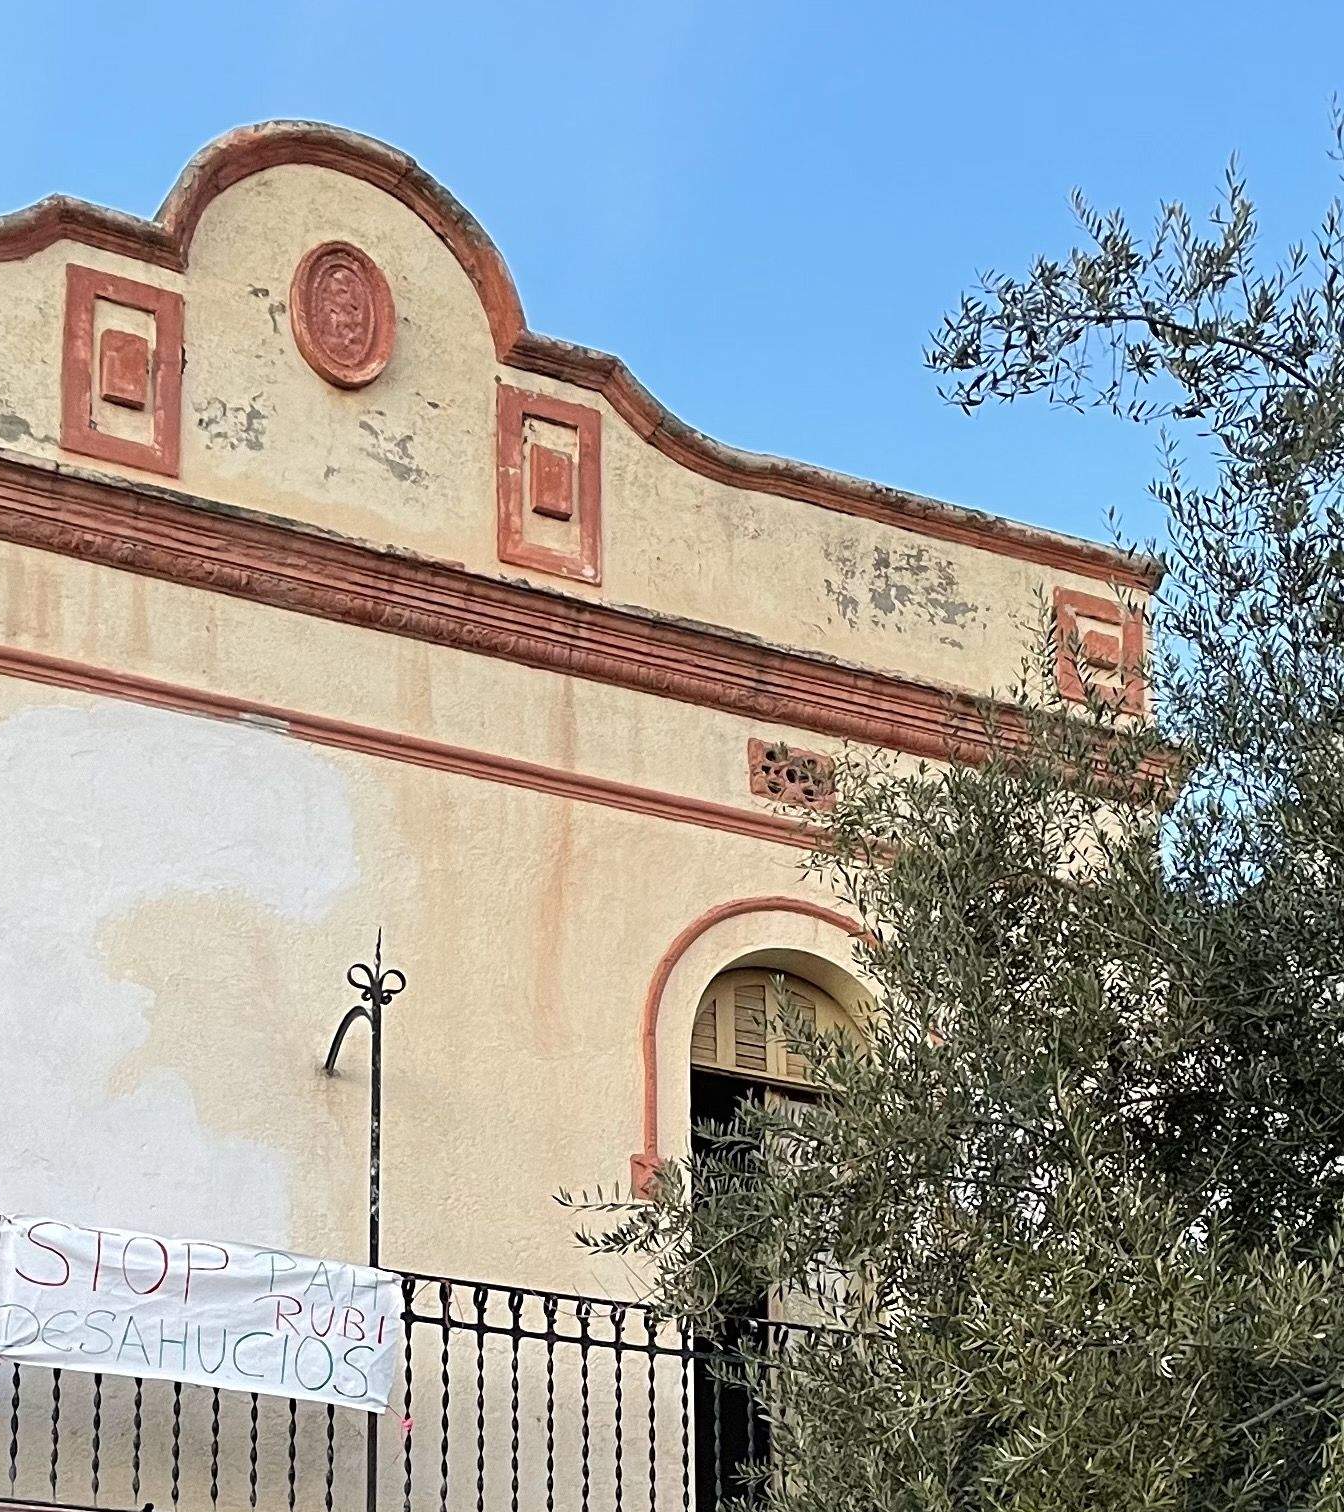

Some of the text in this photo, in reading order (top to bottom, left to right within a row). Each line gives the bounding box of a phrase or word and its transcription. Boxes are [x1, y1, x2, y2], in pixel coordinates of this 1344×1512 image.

[15, 1221, 229, 1304] STOP
[254, 1251, 380, 1311] PAH
[253, 1295, 386, 1344] RUBI
